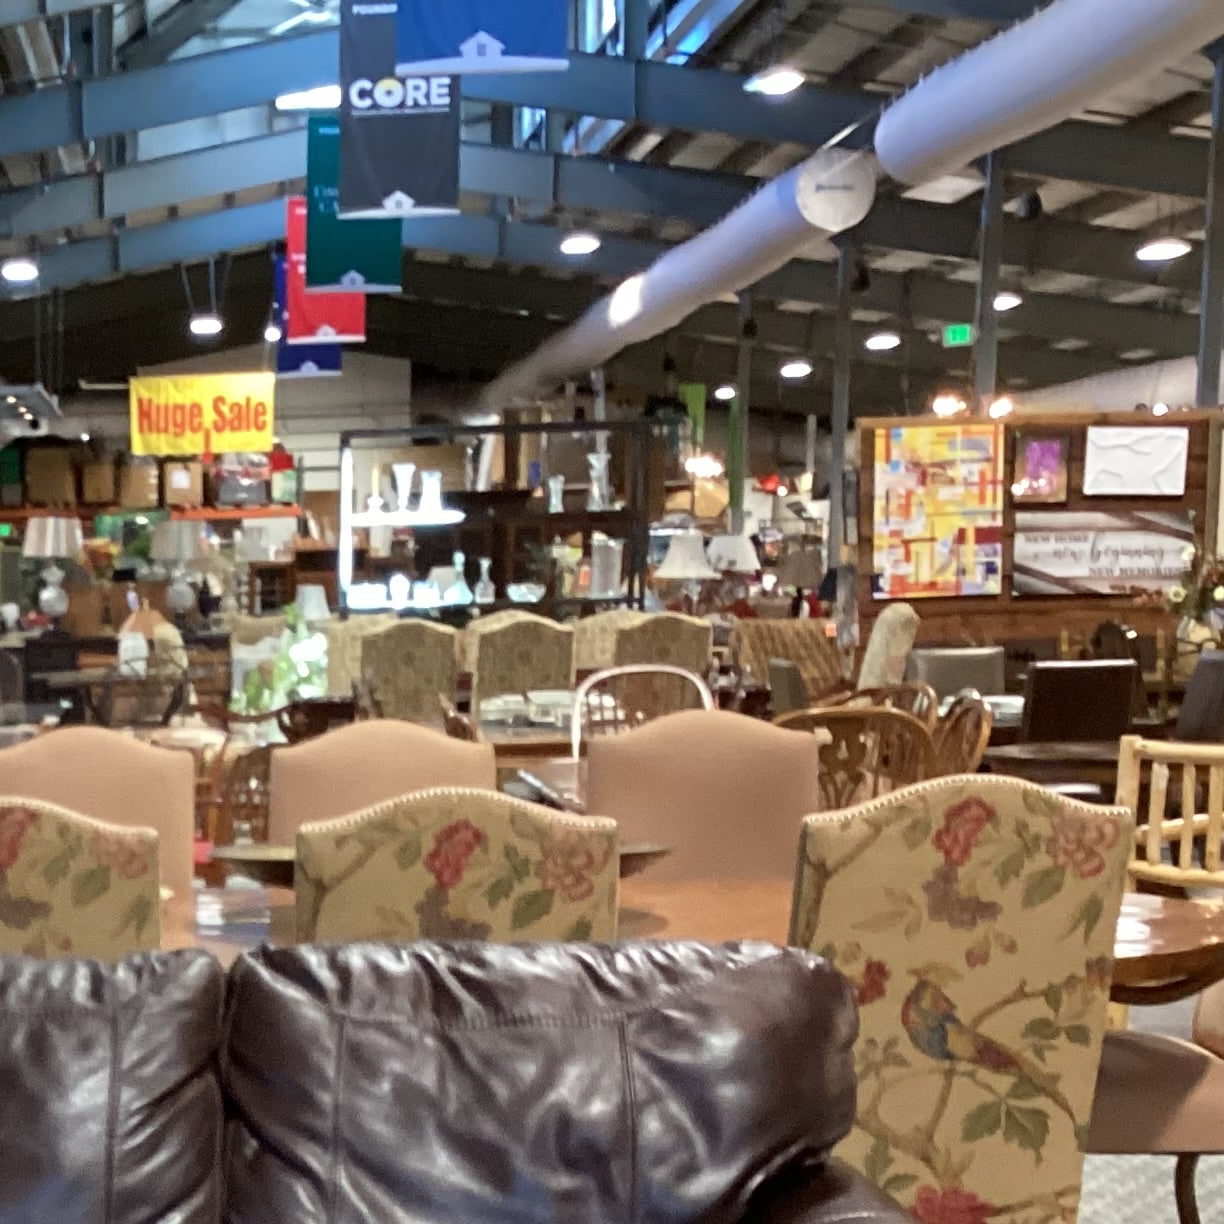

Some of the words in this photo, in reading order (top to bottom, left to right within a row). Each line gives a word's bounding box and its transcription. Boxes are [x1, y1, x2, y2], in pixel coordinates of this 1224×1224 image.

[349, 76, 452, 108] CORE
[138, 397, 203, 437] Huge
[212, 395, 268, 433] Sale
